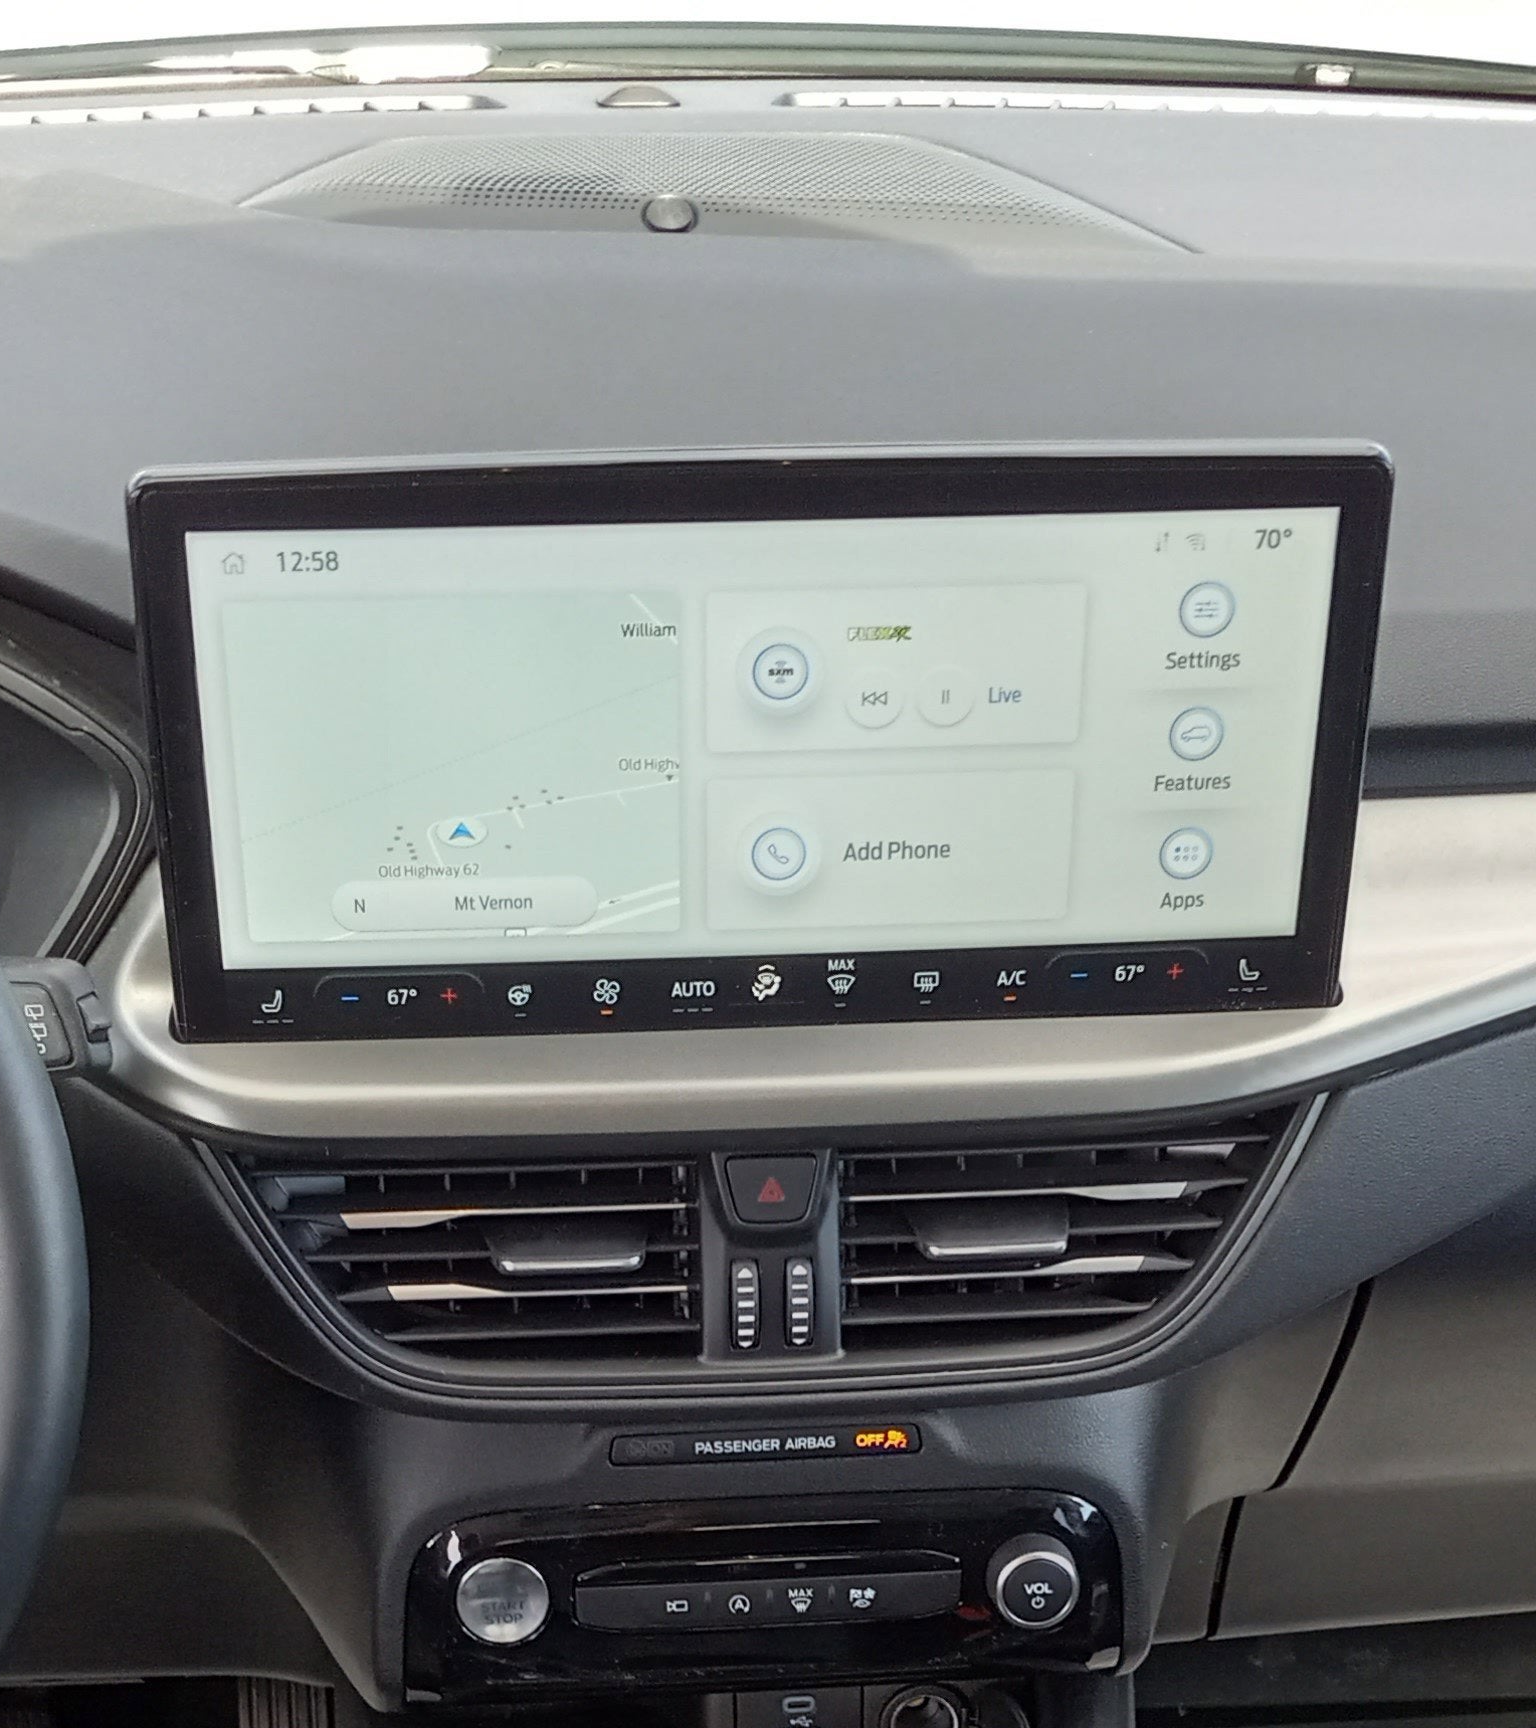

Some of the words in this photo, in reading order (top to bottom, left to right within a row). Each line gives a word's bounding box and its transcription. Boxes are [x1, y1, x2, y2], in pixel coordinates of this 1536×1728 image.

[275, 550, 340, 573] 12:58
[620, 623, 677, 638] William
[1165, 650, 1241, 672] Settings
[988, 686, 1023, 704] Live
[618, 758, 642, 772] Old
[1153, 773, 1232, 793] Features
[843, 839, 885, 863] Add
[888, 837, 951, 861] Phone
[378, 865, 401, 878] Old
[404, 864, 460, 879] Highway
[463, 863, 480, 876] 62
[354, 898, 366, 914] N
[455, 896, 476, 911] Mt
[479, 895, 533, 911] Vernon
[1160, 891, 1205, 911] Apps
[827, 959, 855, 972] MAX
[996, 969, 1027, 988] A/C
[671, 979, 716, 998] AUTO
[695, 1437, 781, 1455] PASSENGER
[785, 1435, 836, 1451] AIRBAG
[855, 1432, 884, 1448] OFF
[788, 1588, 814, 1600] MAX
[1024, 1583, 1054, 1596] VOL
[481, 1601, 524, 1612] START
[484, 1613, 524, 1625] STOP
